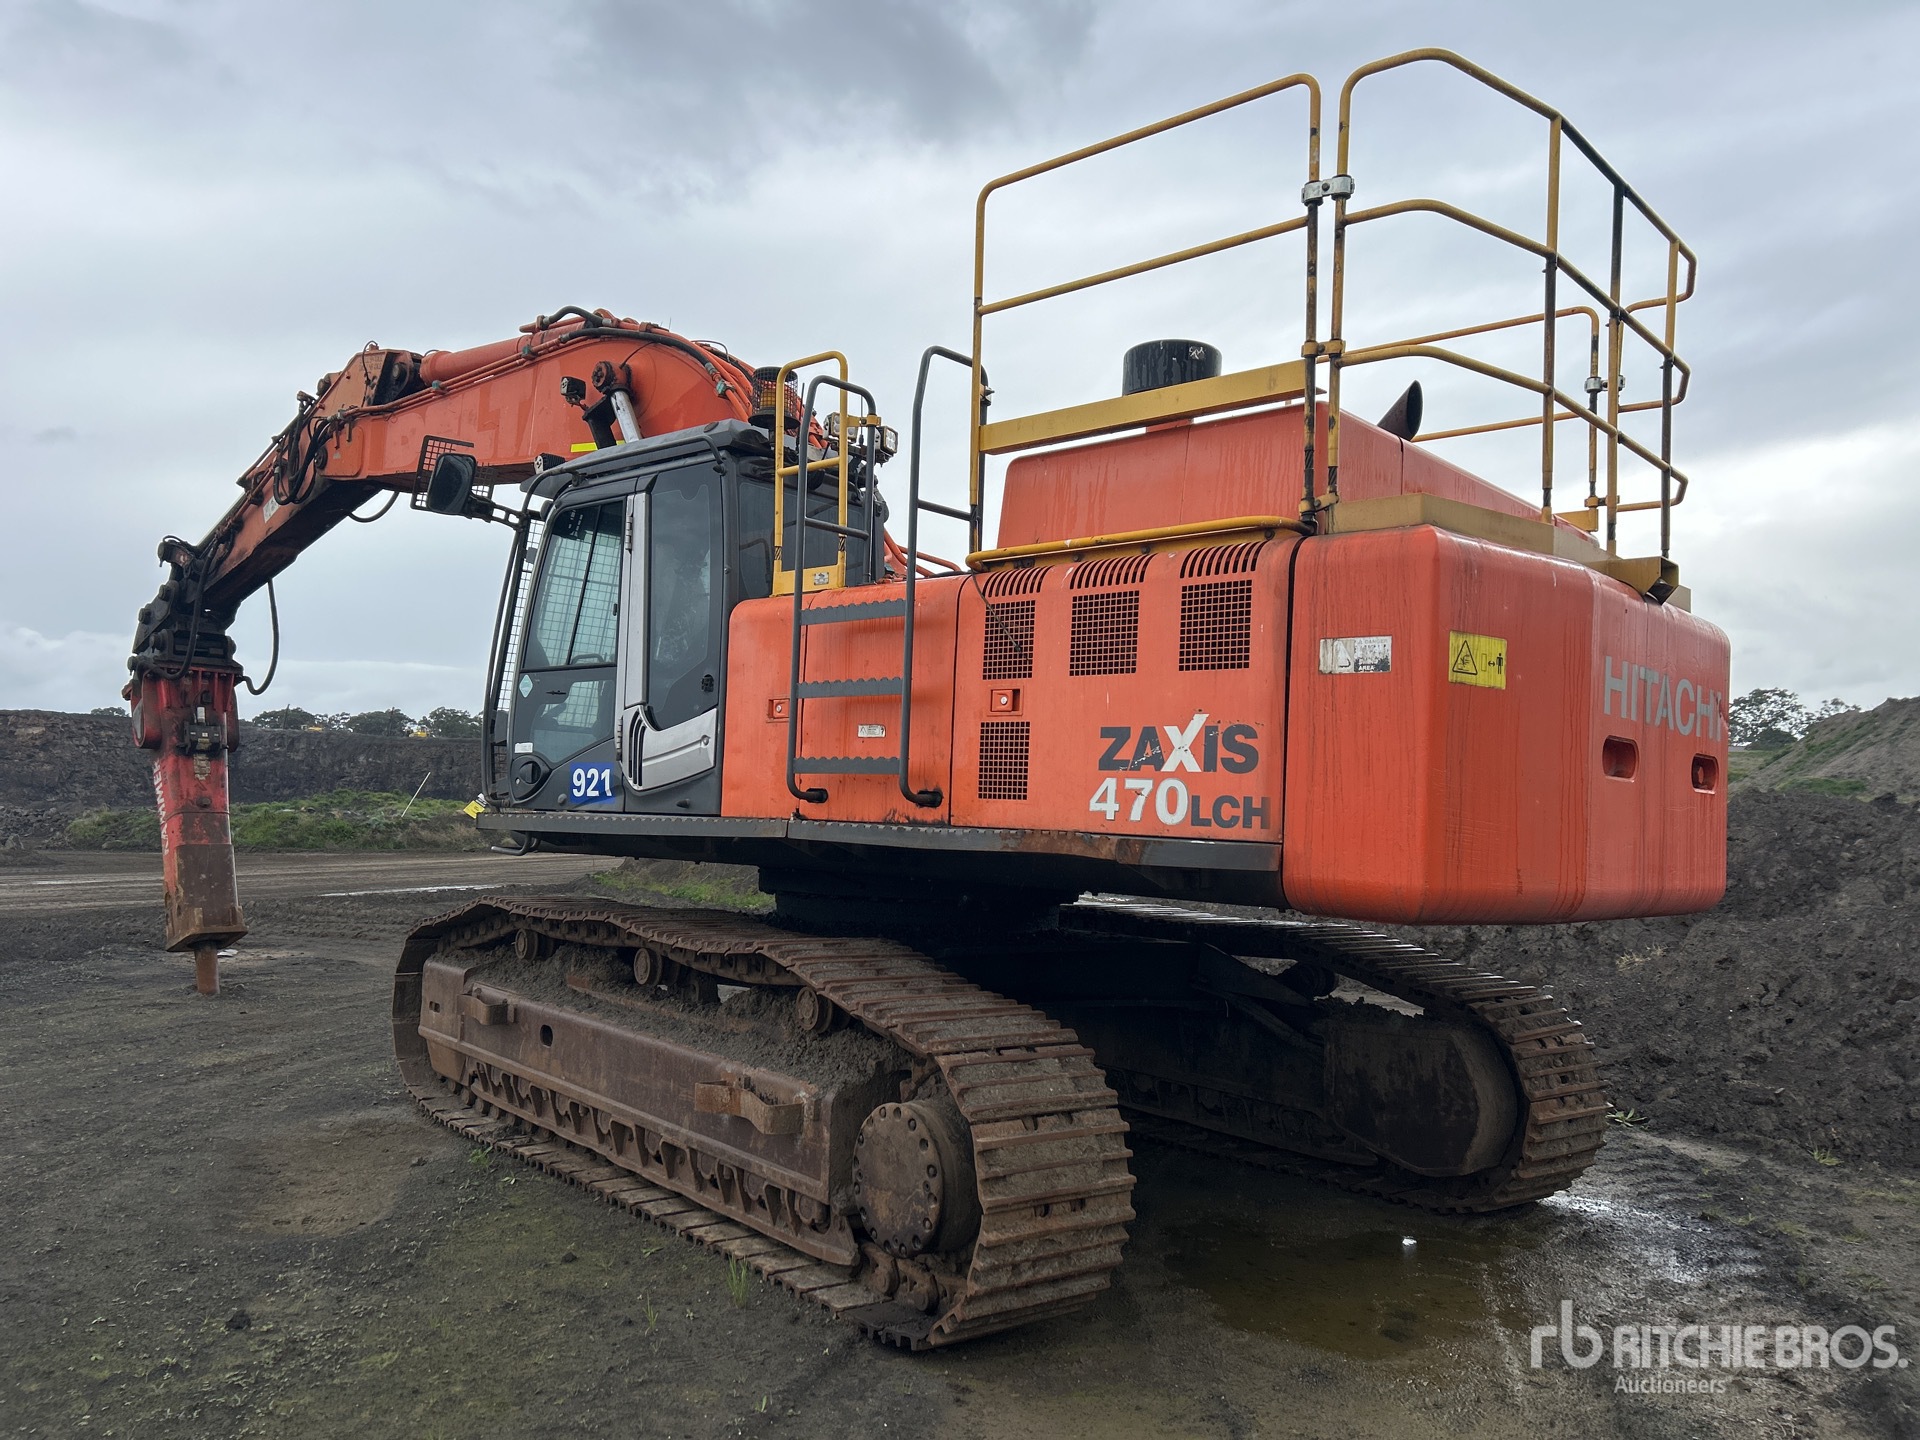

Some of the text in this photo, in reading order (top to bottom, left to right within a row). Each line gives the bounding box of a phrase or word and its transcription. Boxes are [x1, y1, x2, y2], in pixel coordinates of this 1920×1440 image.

[1603, 655, 1721, 743] HITACHI
[1098, 713, 1259, 774] ZAXIS
[572, 767, 613, 798] 921
